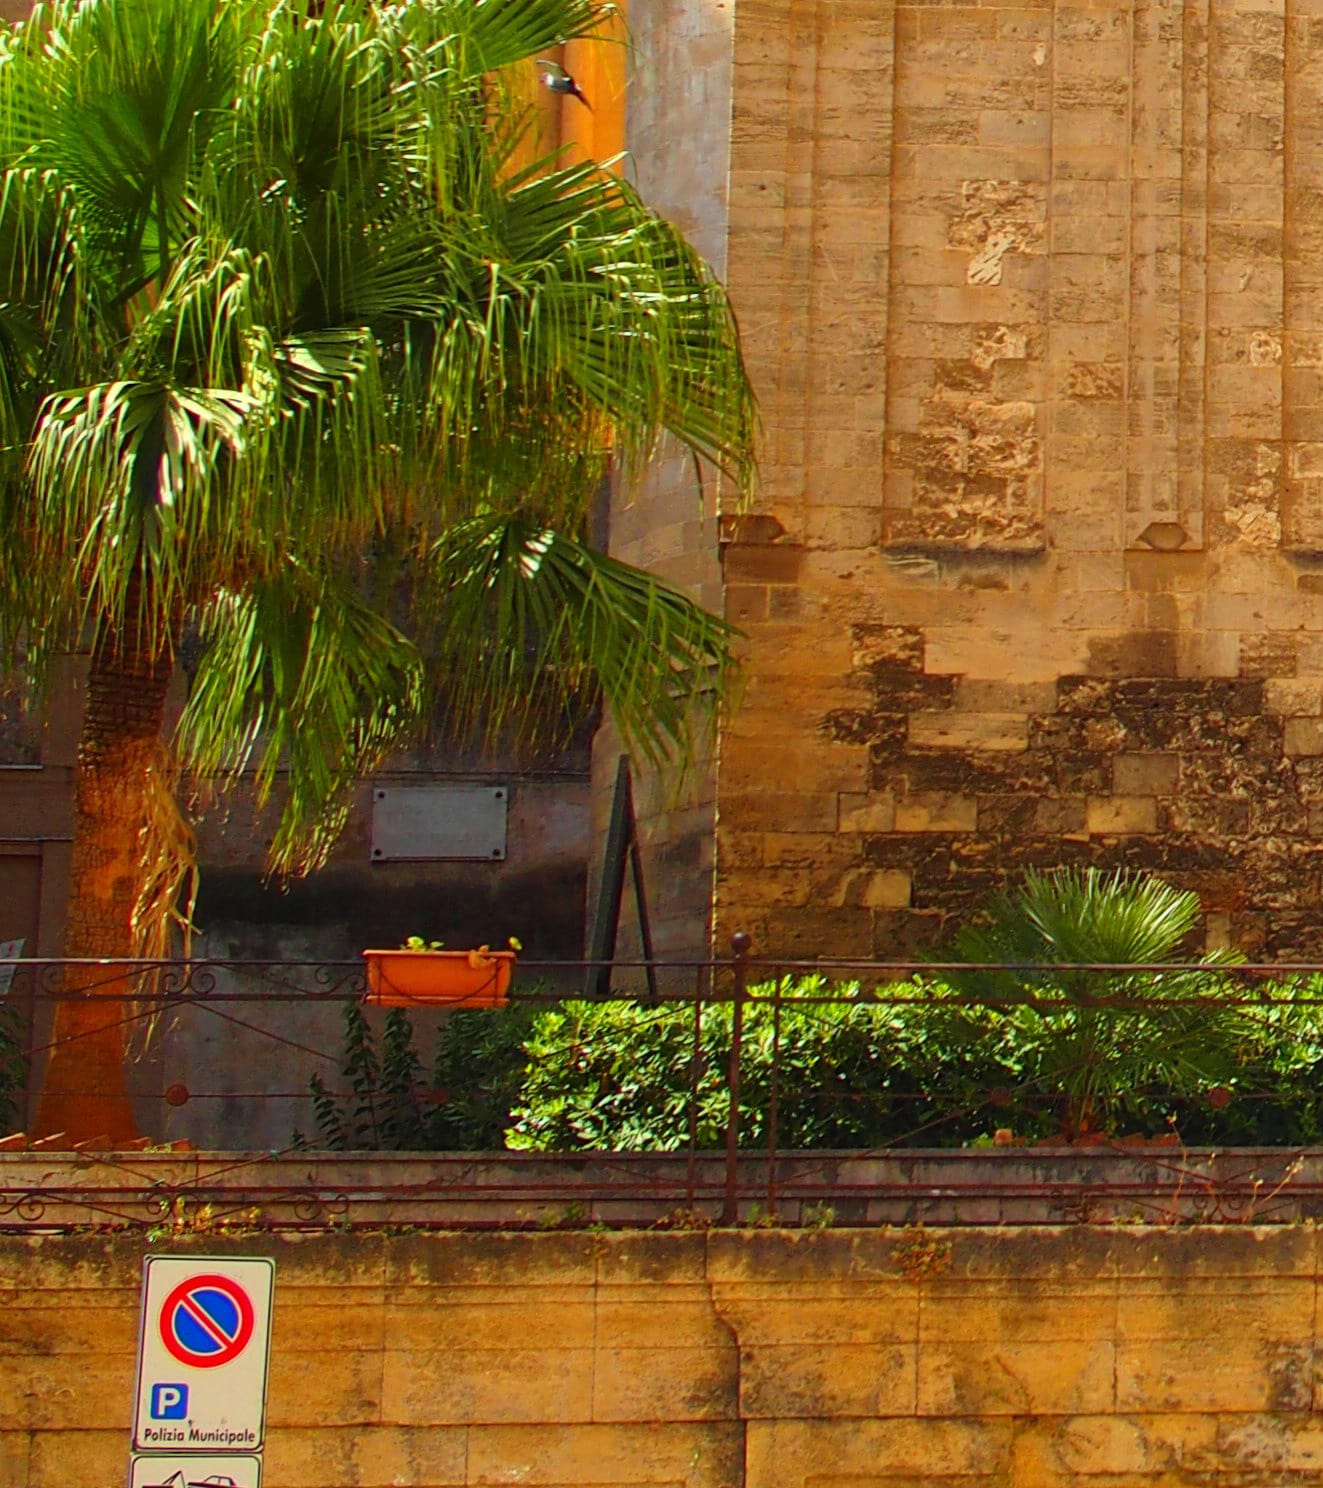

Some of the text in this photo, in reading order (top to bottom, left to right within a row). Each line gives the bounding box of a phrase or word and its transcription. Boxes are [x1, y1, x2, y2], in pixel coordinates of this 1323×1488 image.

[157, 1387, 180, 1416] P
[144, 1428, 255, 1445] Polizia Municipale
